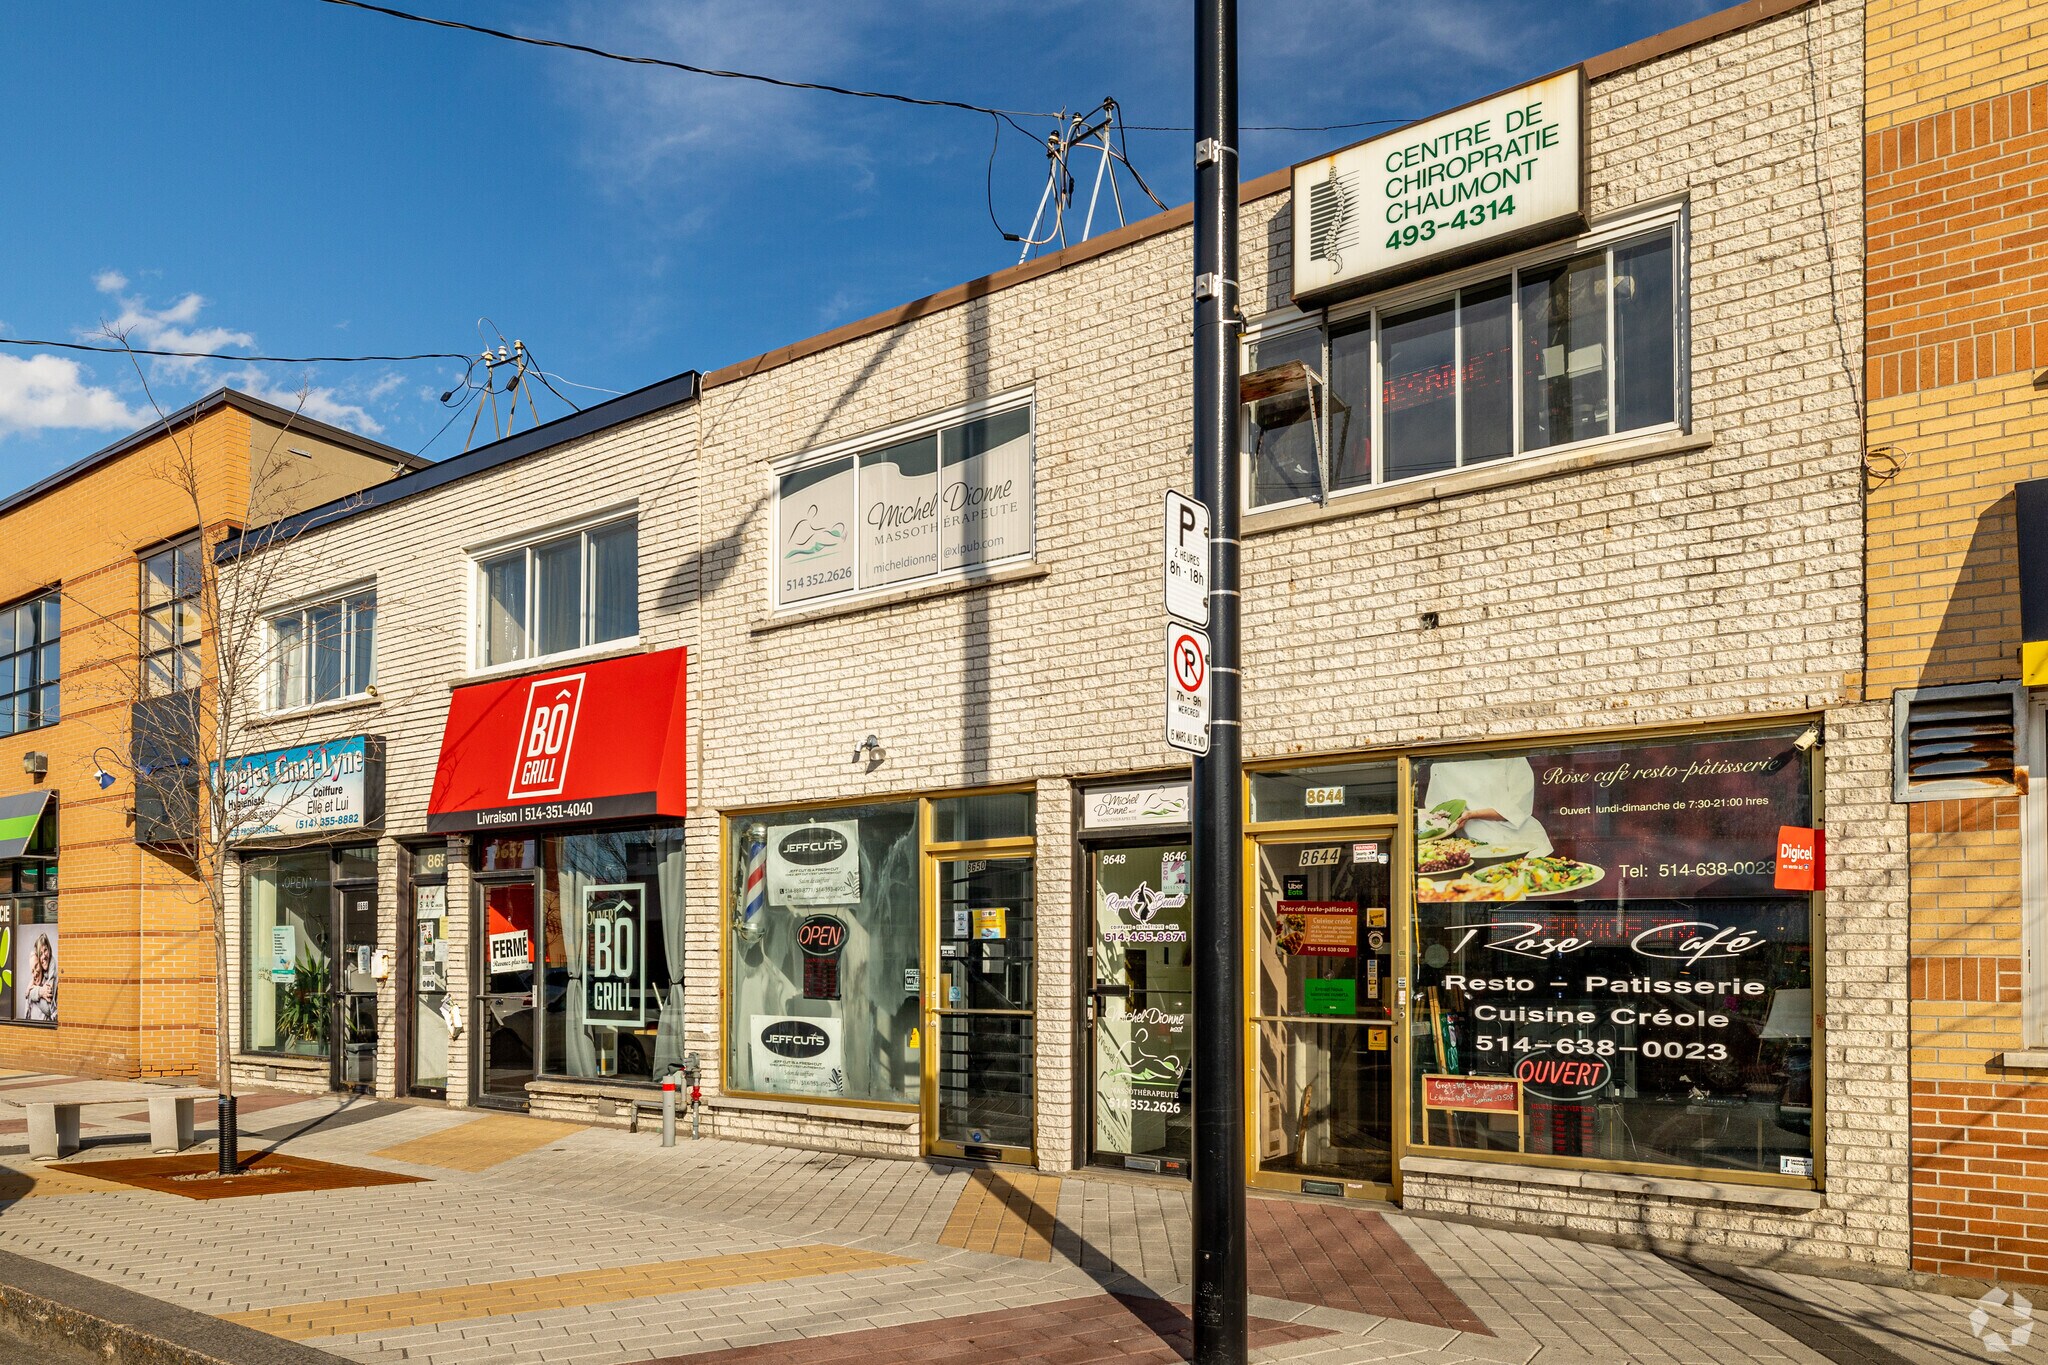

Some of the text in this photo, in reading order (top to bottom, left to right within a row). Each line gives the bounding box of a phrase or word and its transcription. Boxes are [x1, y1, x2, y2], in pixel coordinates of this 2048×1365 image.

[1385, 102, 1543, 173] CENTRE DE
[1385, 123, 1559, 199] CHIROPRATIE
[1385, 158, 1539, 224] CHAUMONT
[1385, 194, 1516, 250] 493-4314
[867, 478, 1013, 531] Michel Dionne
[1180, 503, 1196, 547] P
[1174, 547, 1200, 567] 2 HEURES
[786, 566, 852, 592] 514 352.2626
[1170, 560, 1180, 576] 8h
[1190, 568, 1204, 586] 18h
[1176, 690, 1184, 702] 7h
[1193, 695, 1202, 707] 9h
[1178, 704, 1200, 718] MERCREDI
[526, 688, 572, 758] BÔ
[1171, 729, 1175, 740] 15
[1176, 731, 1186, 743] MARS
[1187, 733, 1192, 745] AU
[275, 748, 364, 785] Gnai-Lyne
[521, 758, 556, 785] GRILL
[1542, 755, 1782, 790] Rose café resto-pâtisserie
[313, 785, 344, 798] Coiffure
[1306, 789, 1344, 805] 8644
[307, 796, 349, 815] Elle et Lui
[477, 810, 517, 825] Livraison
[525, 801, 593, 821] 514-351-4040
[1093, 792, 1140, 817] Michel Dionne
[1559, 796, 1769, 816] Ouvert lundi-dimanche de 7:30-21:00 hres
[295, 813, 359, 830] (514) 355-8882
[427, 853, 445, 868] 865
[1103, 854, 1126, 865] 8648
[1162, 851, 1187, 862] 8646
[1301, 848, 1339, 865] 8644
[1780, 843, 1813, 863] Digicel
[967, 861, 986, 872] 8650
[1619, 861, 1776, 878] Tel: 514-638-0023
[284, 877, 308, 889] OPEN
[1151, 893, 1186, 910] Beauté
[492, 932, 528, 959] FERMÉ
[594, 899, 634, 978] BÔ
[799, 925, 842, 946] OPEN
[1104, 931, 1187, 943] 514.465.8871
[1444, 921, 1592, 960] Rose
[1631, 922, 1766, 967] Café
[1445, 975, 1534, 992] Resto
[1586, 976, 1766, 996] Patisserie
[594, 982, 634, 1012] GRILL
[1146, 1007, 1184, 1025] Dionne
[1474, 1005, 1730, 1028] Cuisine Créole
[1475, 1035, 1728, 1061] 514-638-0023
[1519, 1060, 1604, 1086] OUVERT
[1131, 1099, 1181, 1114] 352.2626
